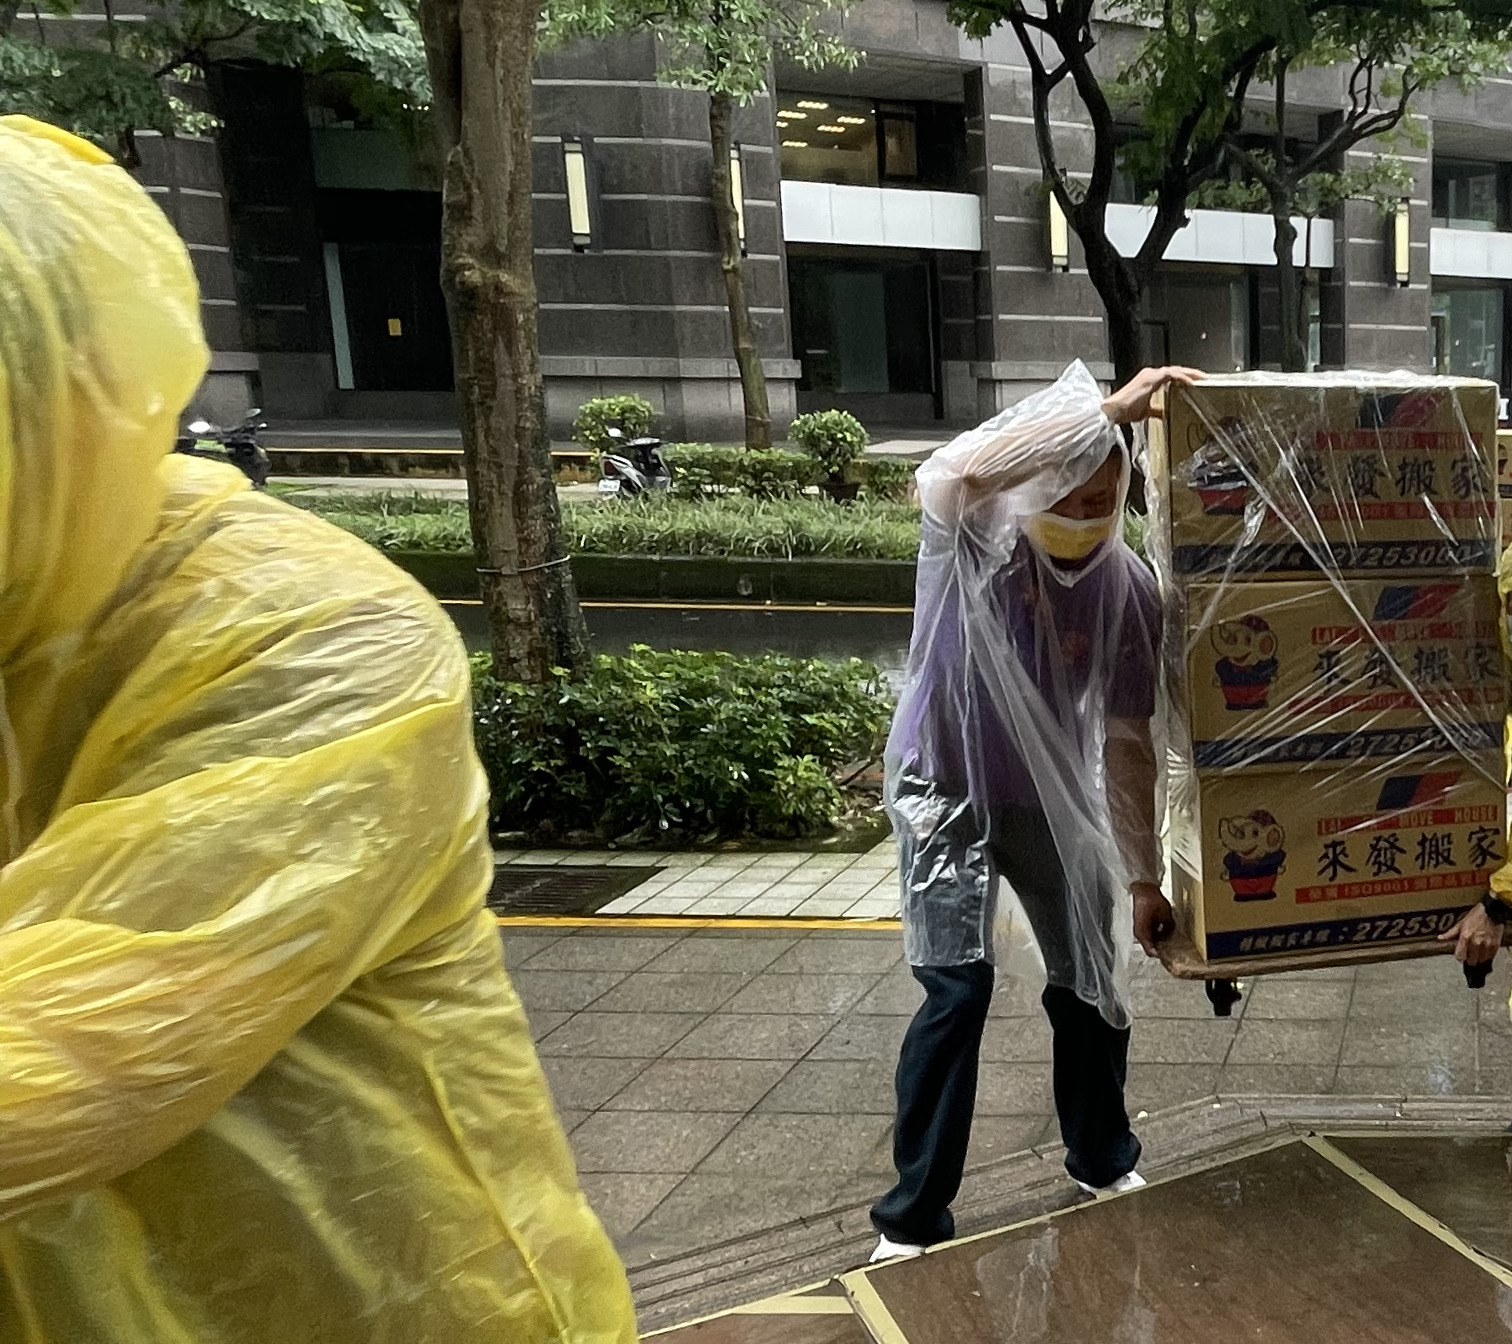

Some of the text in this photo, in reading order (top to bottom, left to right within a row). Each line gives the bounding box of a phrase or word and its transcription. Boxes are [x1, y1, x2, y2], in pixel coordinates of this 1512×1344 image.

[1454, 806, 1495, 824] HOUSE
[1317, 824, 1503, 883] 來發搬家
